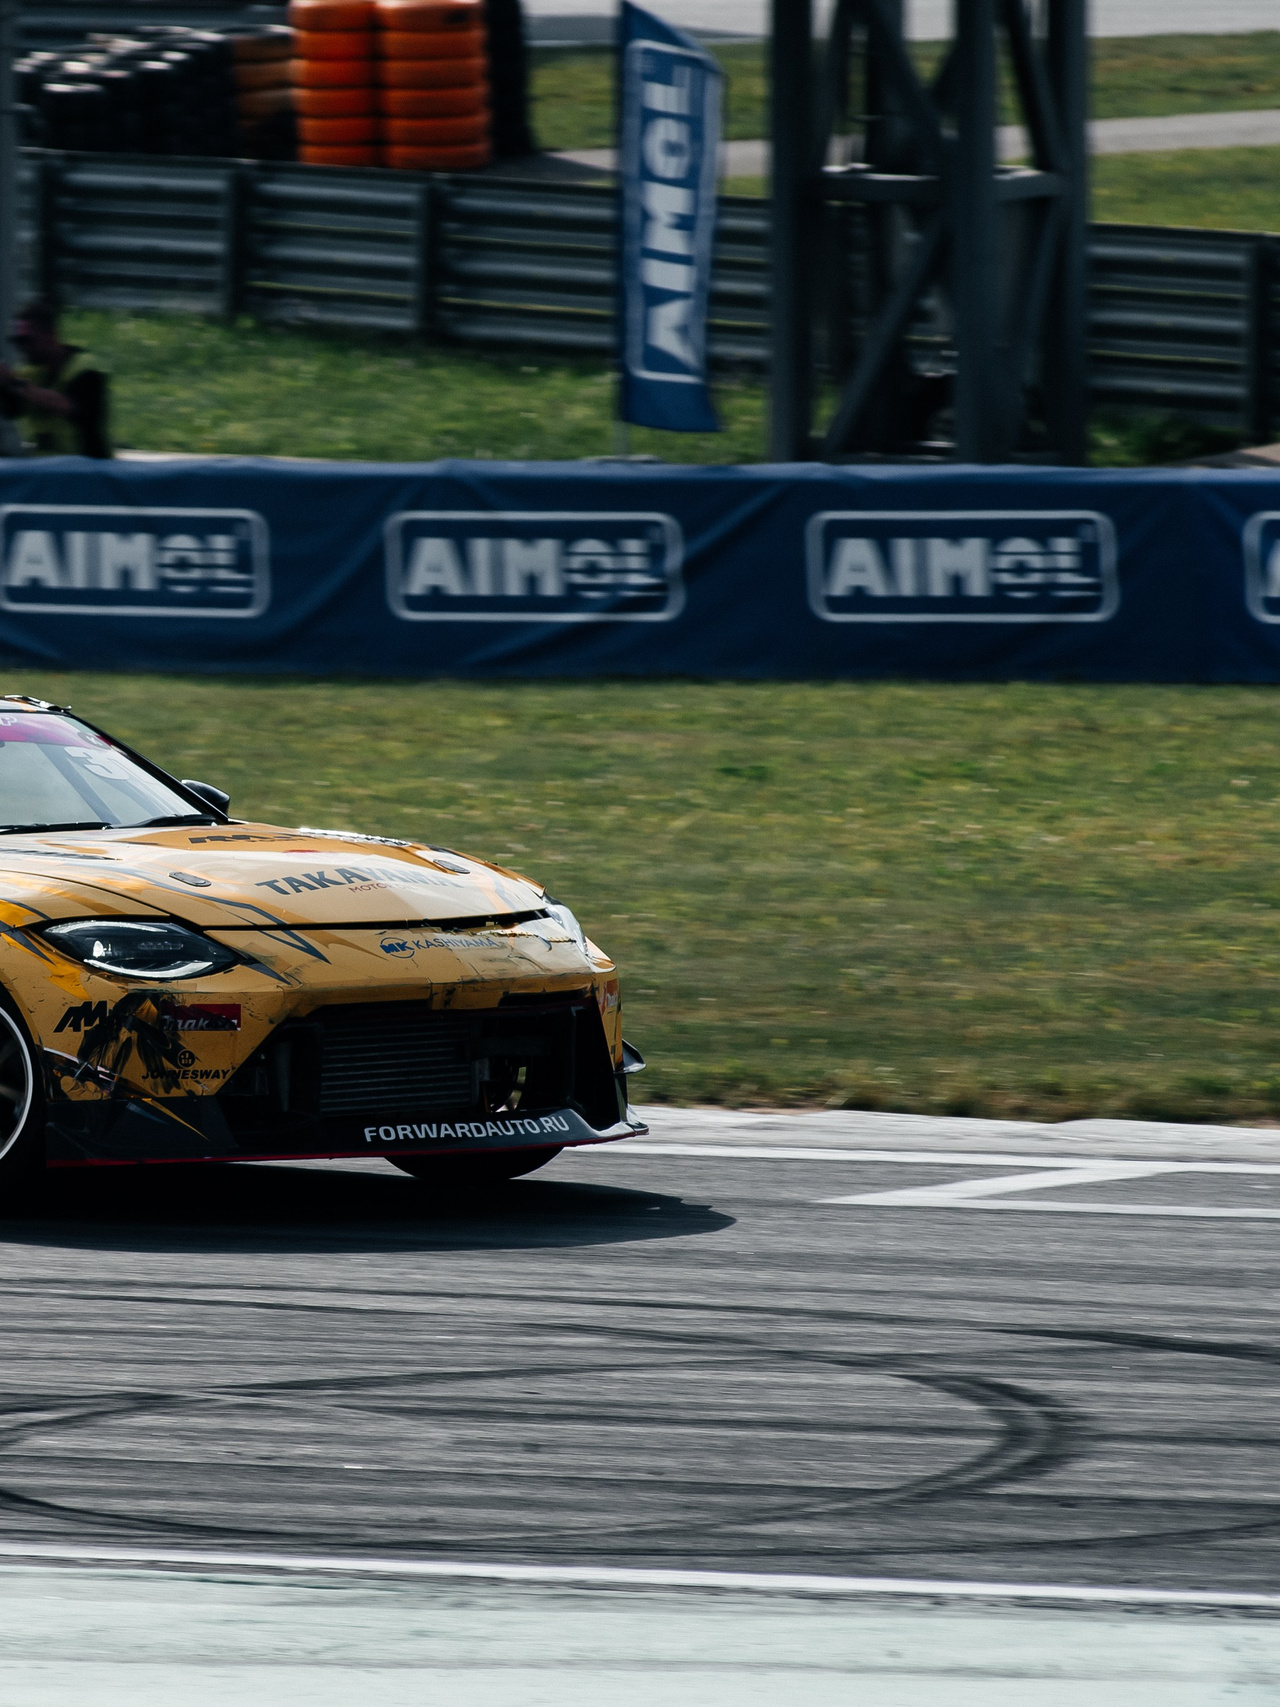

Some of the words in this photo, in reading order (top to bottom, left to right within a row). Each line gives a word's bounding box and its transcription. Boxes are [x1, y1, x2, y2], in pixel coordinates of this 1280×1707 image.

[5, 530, 253, 593] AIMOL
[405, 536, 666, 599] AIMOL
[824, 536, 1100, 599] AIMOL
[255, 866, 465, 896] TAKAYAMA
[413, 937, 500, 950] KASHIYAMA
[364, 1115, 570, 1142] FORWARDAUTO.RU
